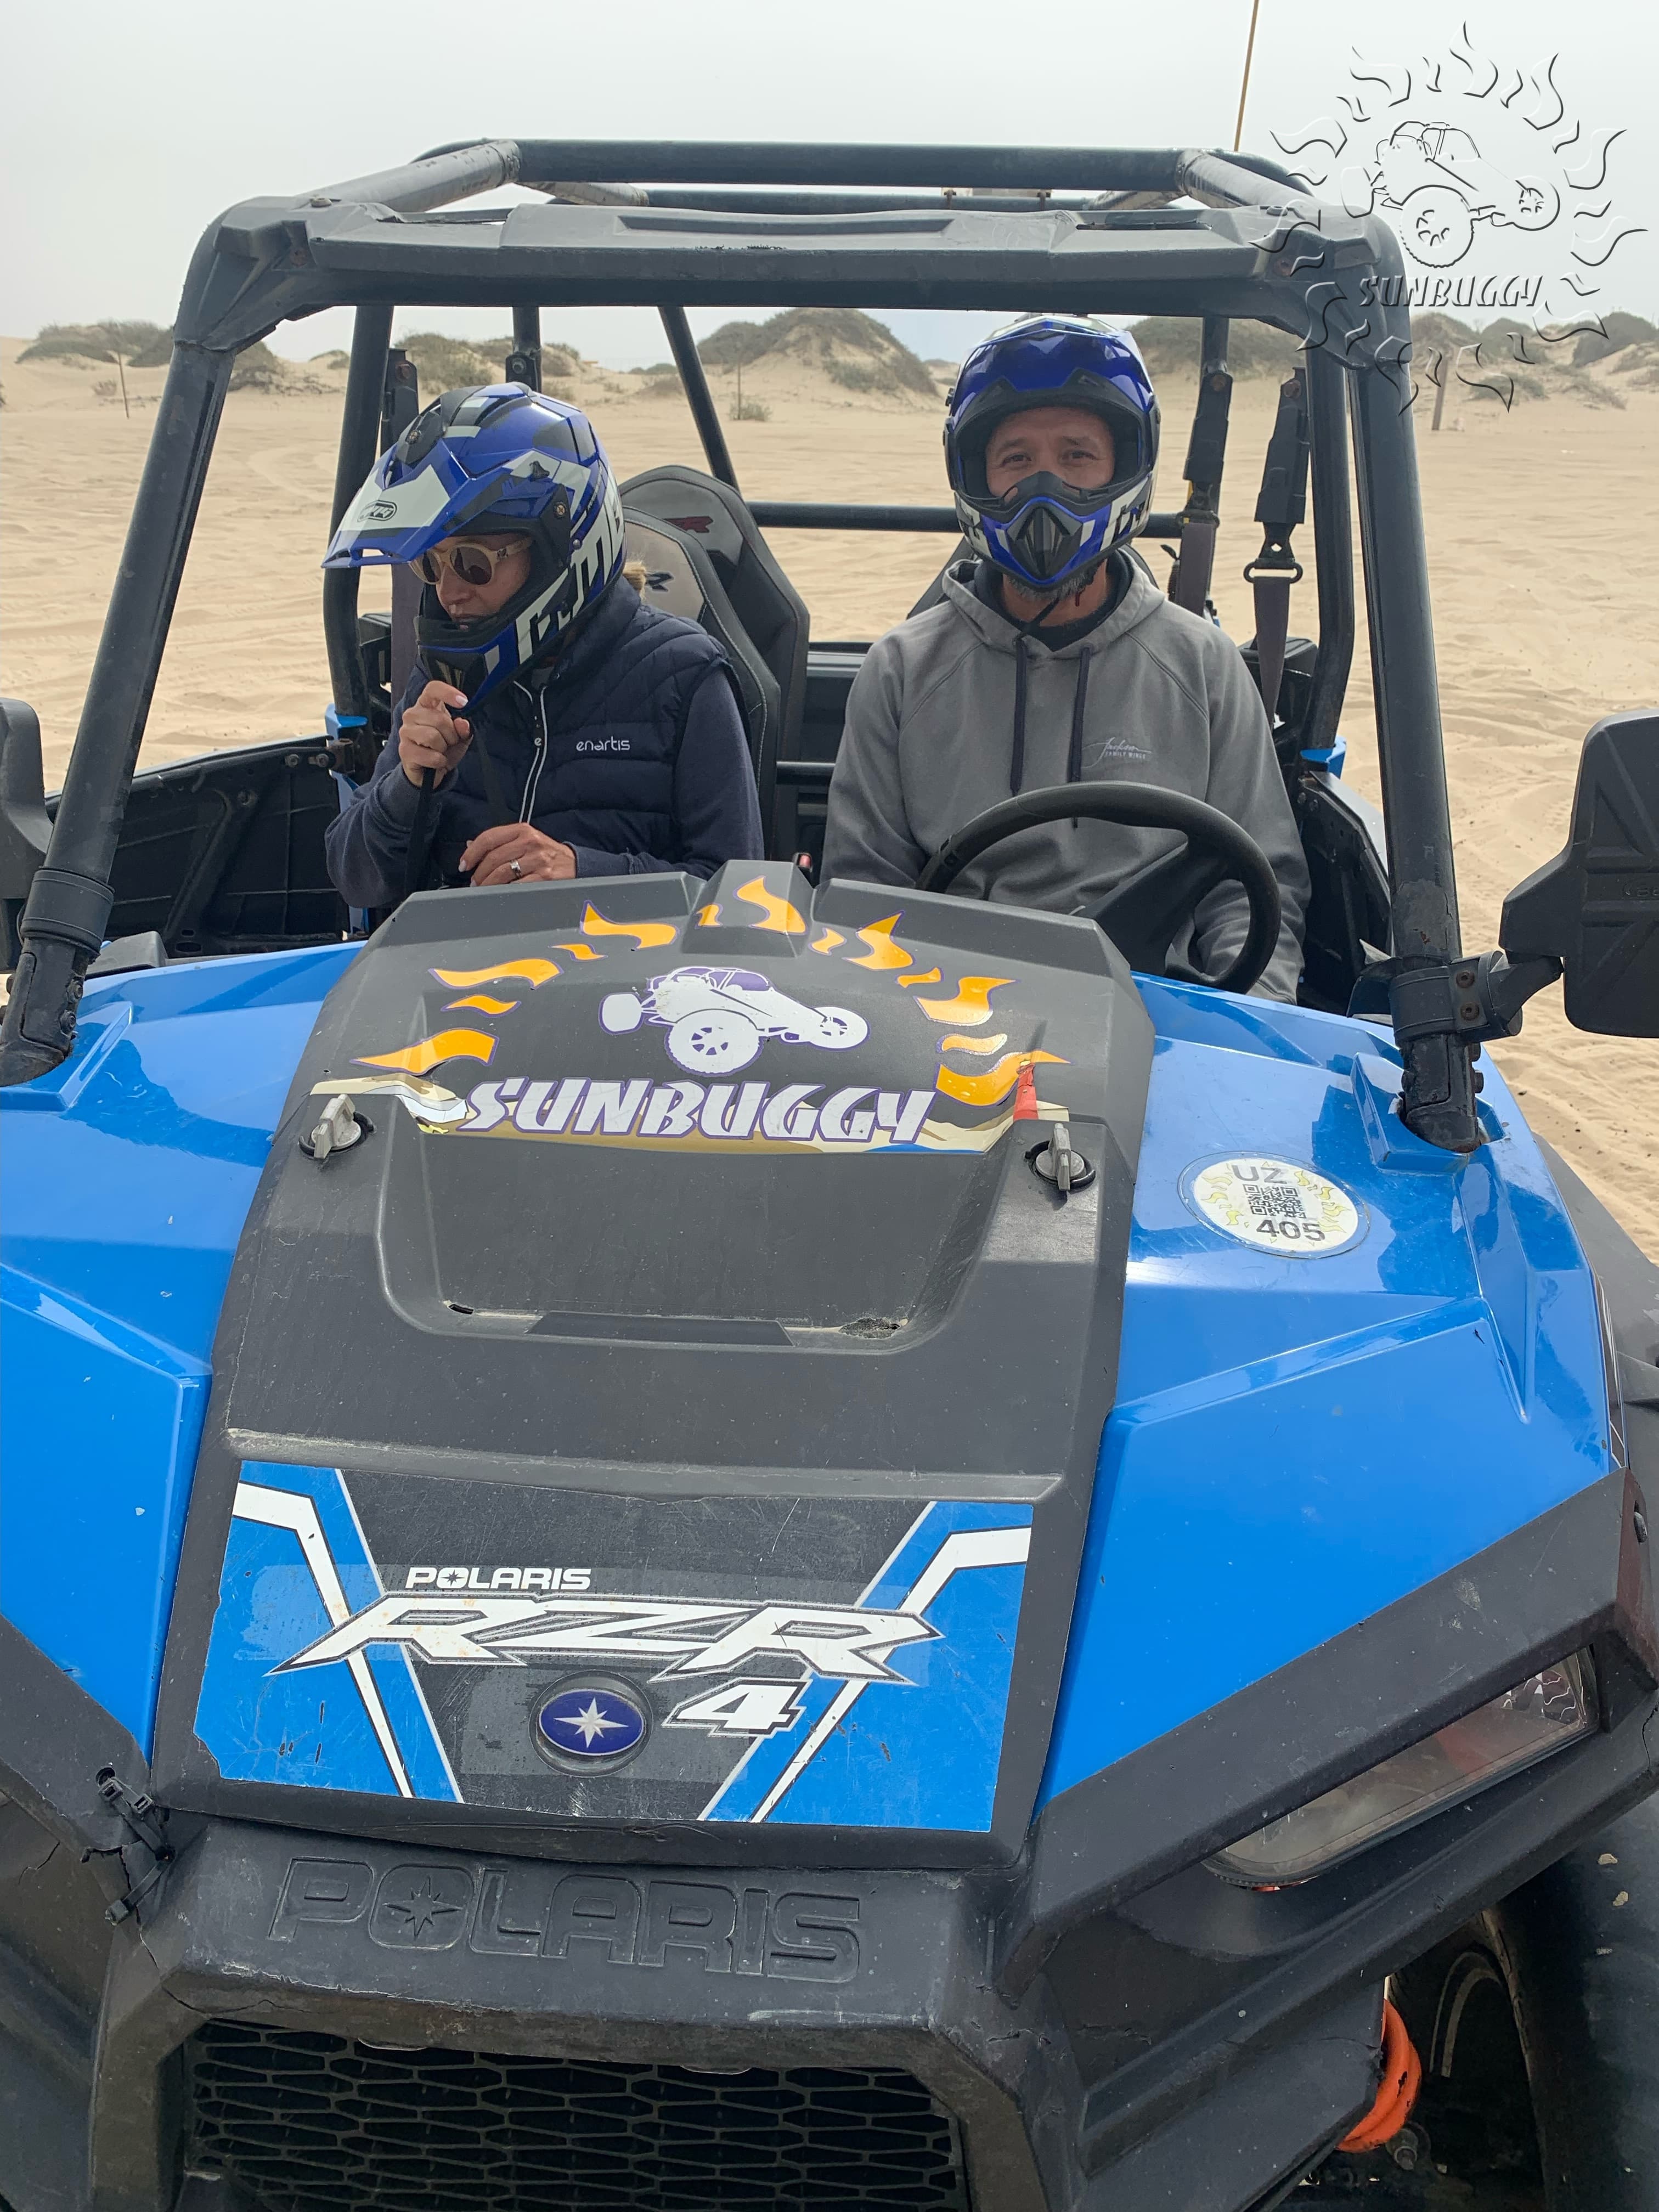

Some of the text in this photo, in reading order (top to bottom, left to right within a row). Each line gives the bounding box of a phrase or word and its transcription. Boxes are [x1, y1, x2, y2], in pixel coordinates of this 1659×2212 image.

[576, 736, 630, 751] enartis
[458, 1076, 936, 1143] SUNBUGGY
[1232, 1165, 1287, 1184] UZ
[1256, 1219, 1326, 1241] 405
[405, 1566, 591, 1590] POLARIS
[264, 1591, 945, 1685] RZR
[661, 1677, 811, 1738] 4
[268, 1857, 861, 1983] POLARIS
